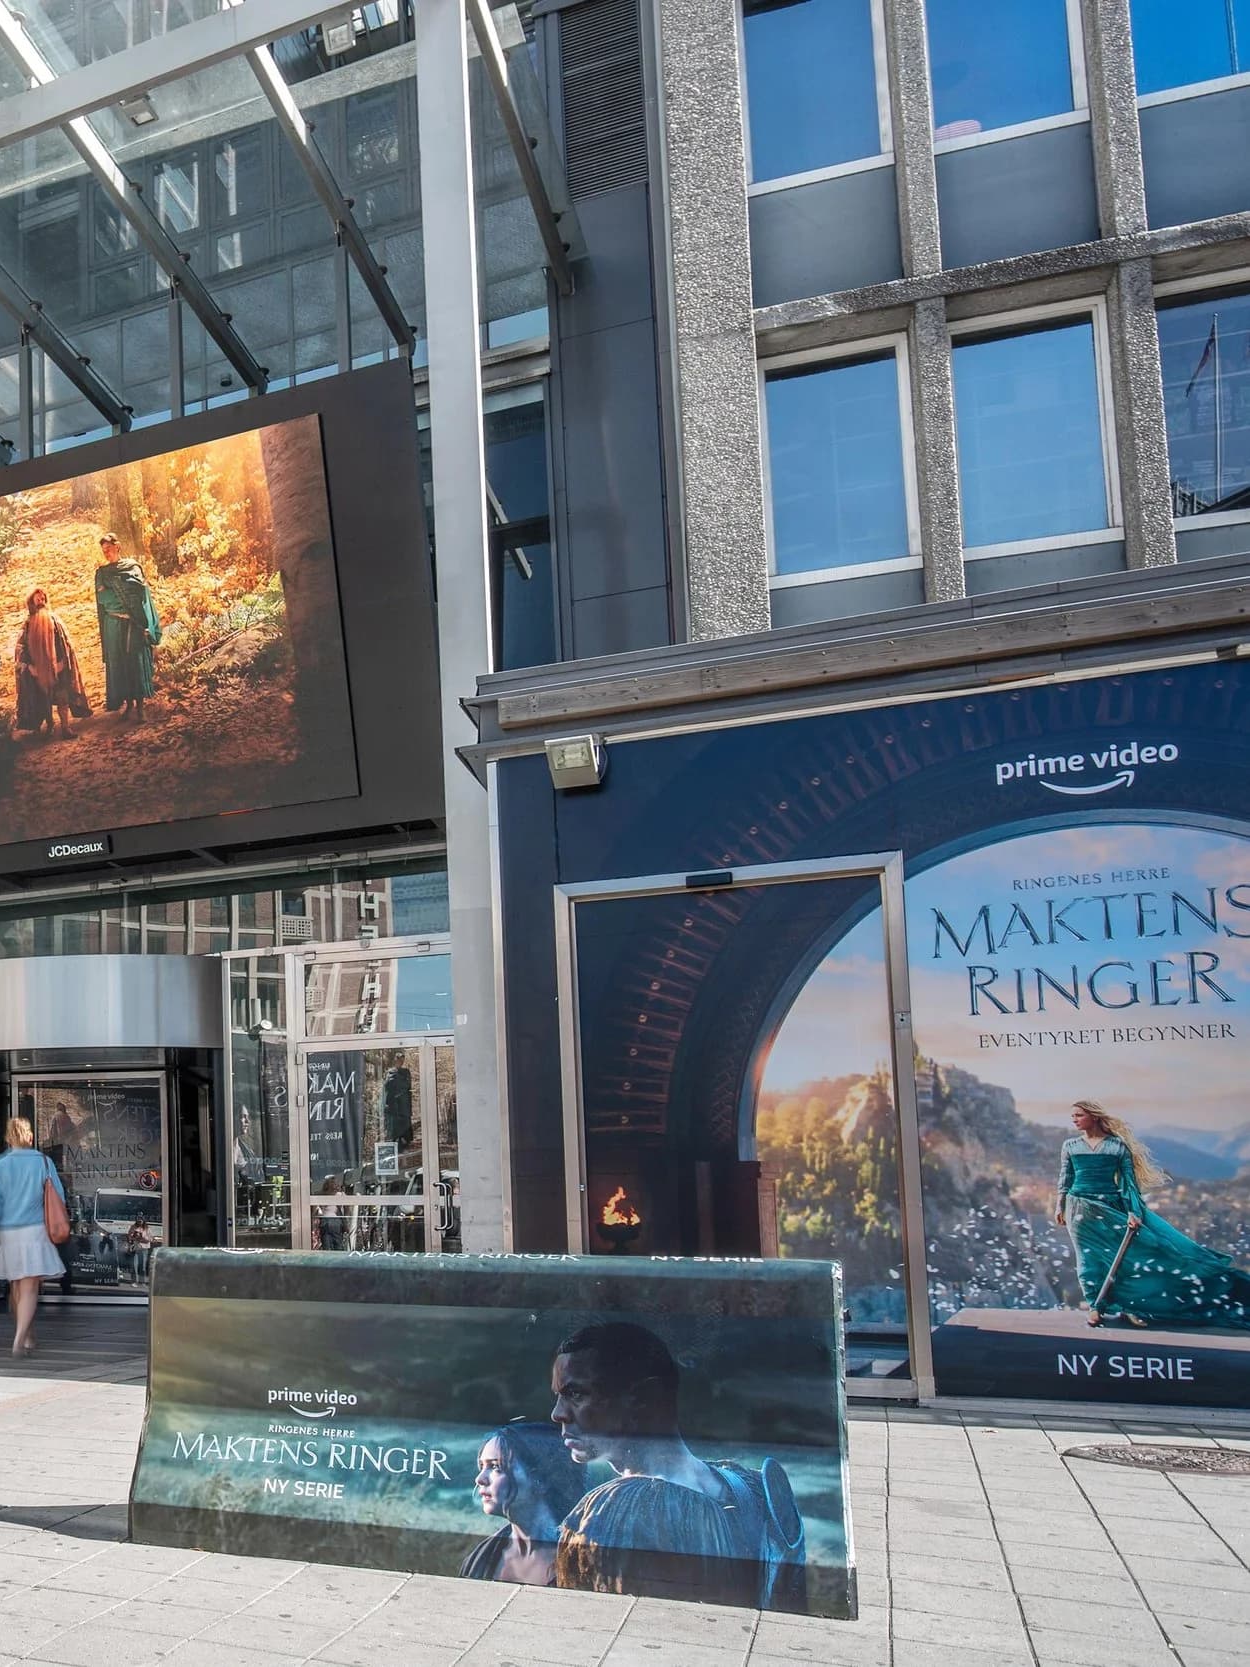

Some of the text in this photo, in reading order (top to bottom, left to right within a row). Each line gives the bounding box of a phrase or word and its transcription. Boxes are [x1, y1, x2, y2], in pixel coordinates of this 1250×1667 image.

[995, 741, 1180, 785] prime video
[47, 841, 103, 859] JCDecaux
[1012, 867, 1170, 891] RINGENES HERRE
[930, 883, 1250, 959] MAKTENS
[966, 951, 1237, 1016] RINGER
[978, 1023, 1237, 1049] EVENTYRET BEGYNNER
[67, 1143, 147, 1160] MAKTENS
[1057, 1353, 1194, 1381] NY SERIE
[267, 1386, 358, 1406] prime video
[267, 1424, 356, 1439] RINGENES HERRE
[171, 1431, 452, 1480] MAKTENS RINGER
[263, 1477, 345, 1499] NY SERIE
